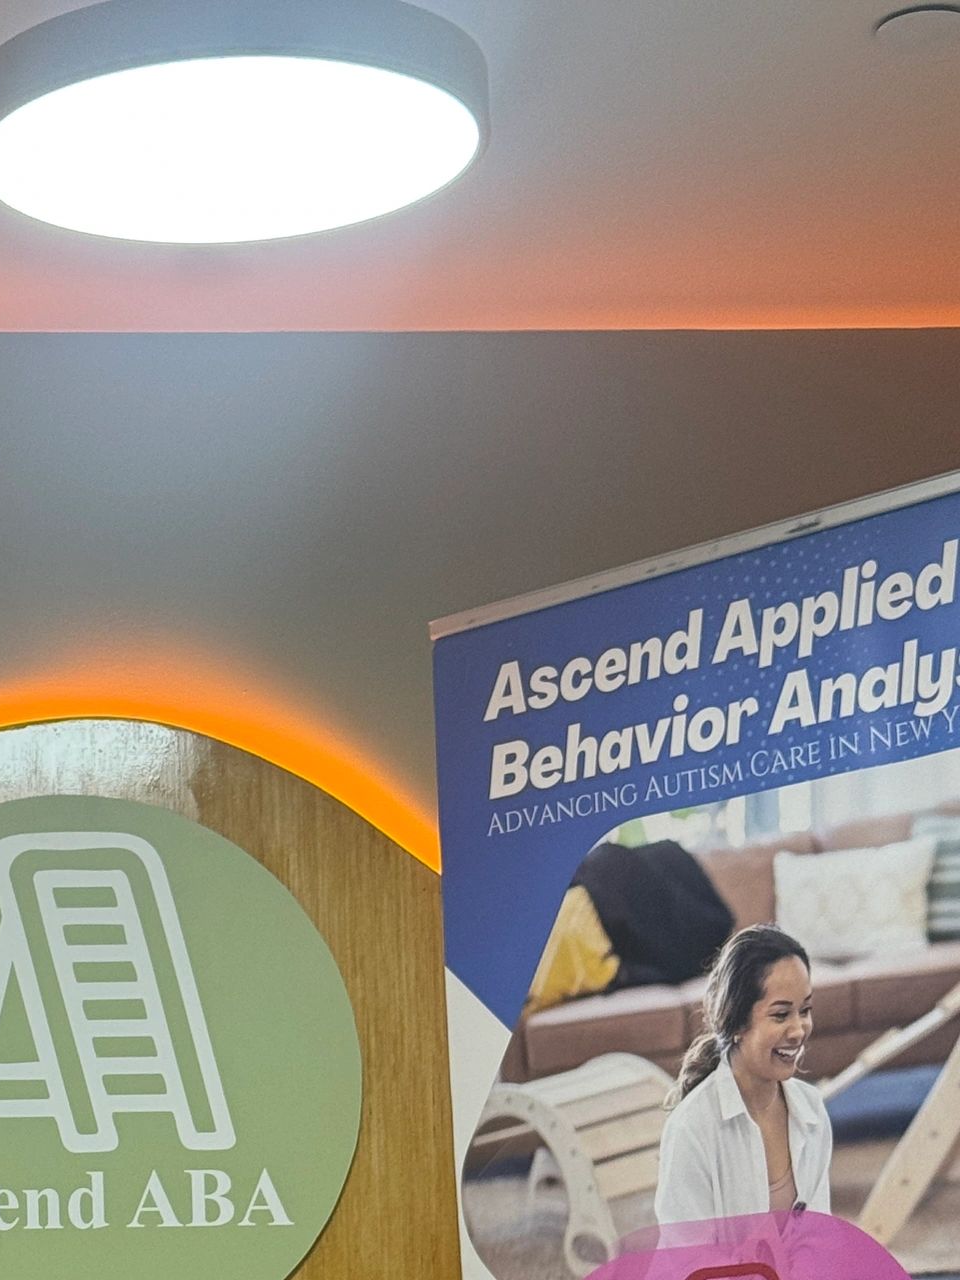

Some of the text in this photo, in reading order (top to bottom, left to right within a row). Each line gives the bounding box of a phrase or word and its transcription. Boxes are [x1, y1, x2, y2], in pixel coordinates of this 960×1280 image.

[483, 538, 959, 722] Ascend Applied
[487, 784, 639, 837] ADVANCING
[644, 762, 744, 801] AUTISM
[750, 741, 821, 777] CARE
[829, 730, 859, 760] IN
[869, 713, 932, 753] NEW
[489, 638, 960, 800] Behavior Analy
[126, 1167, 295, 1229] ABA
